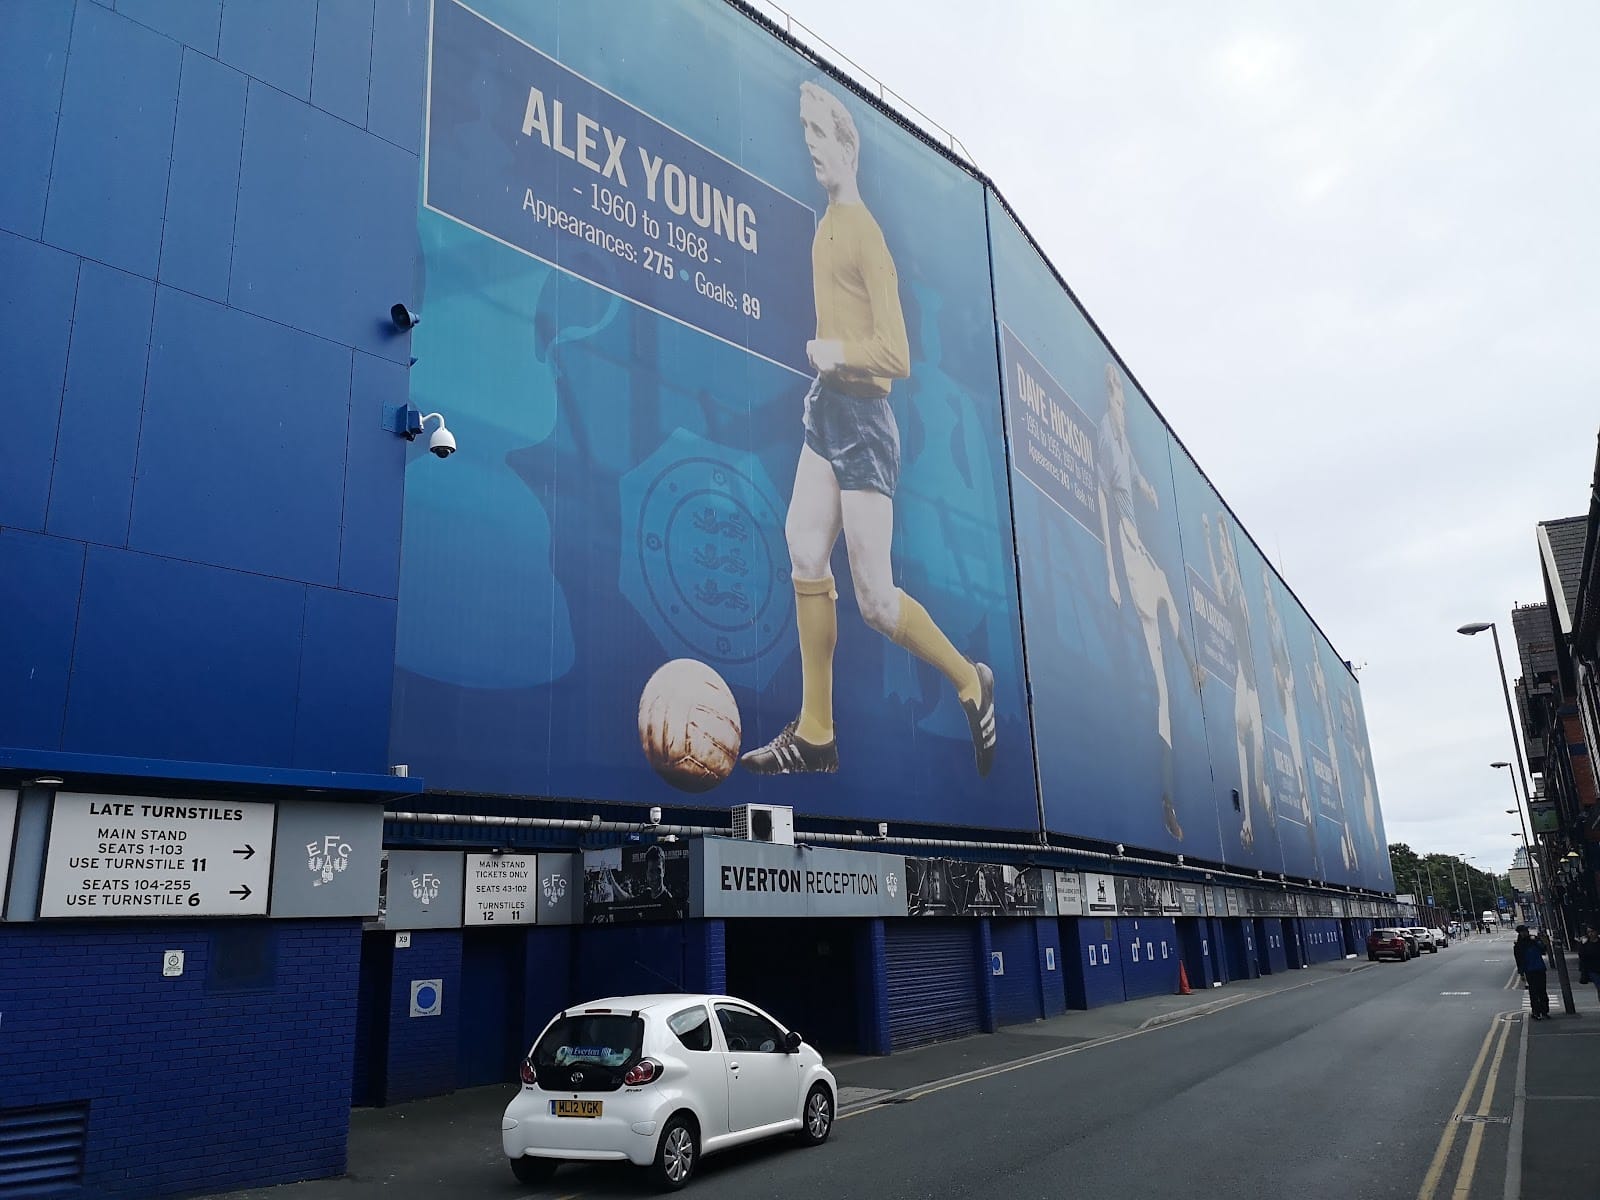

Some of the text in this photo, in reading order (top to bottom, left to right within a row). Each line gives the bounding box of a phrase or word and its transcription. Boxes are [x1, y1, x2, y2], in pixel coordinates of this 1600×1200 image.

[522, 86, 758, 254] ALEX YOUNG
[591, 183, 637, 228] 1960
[641, 212, 660, 240] to
[667, 221, 709, 263] 1968
[522, 188, 761, 320] Appearances: 275 Goals: 89
[1016, 362, 1095, 472] DAVE HICKSON
[89, 802, 243, 821] LATE TURNSTILES
[97, 828, 187, 841] MAIN STAND
[98, 843, 183, 855] SEATS 1-103
[69, 857, 207, 872] USE TURNSTILE 11
[479, 860, 526, 869] MAIN STAND
[475, 870, 508, 878] TICKETS
[720, 865, 878, 895] EVERTON RECEPTION
[82, 879, 191, 891] SEATS 104-255
[476, 885, 528, 893] SEATS 43-102
[66, 892, 201, 907] USE TURNSTILE 6
[477, 901, 526, 910] TURNSTILES
[482, 910, 520, 921] 12 11
[558, 1101, 600, 1114] ML12 VGK
